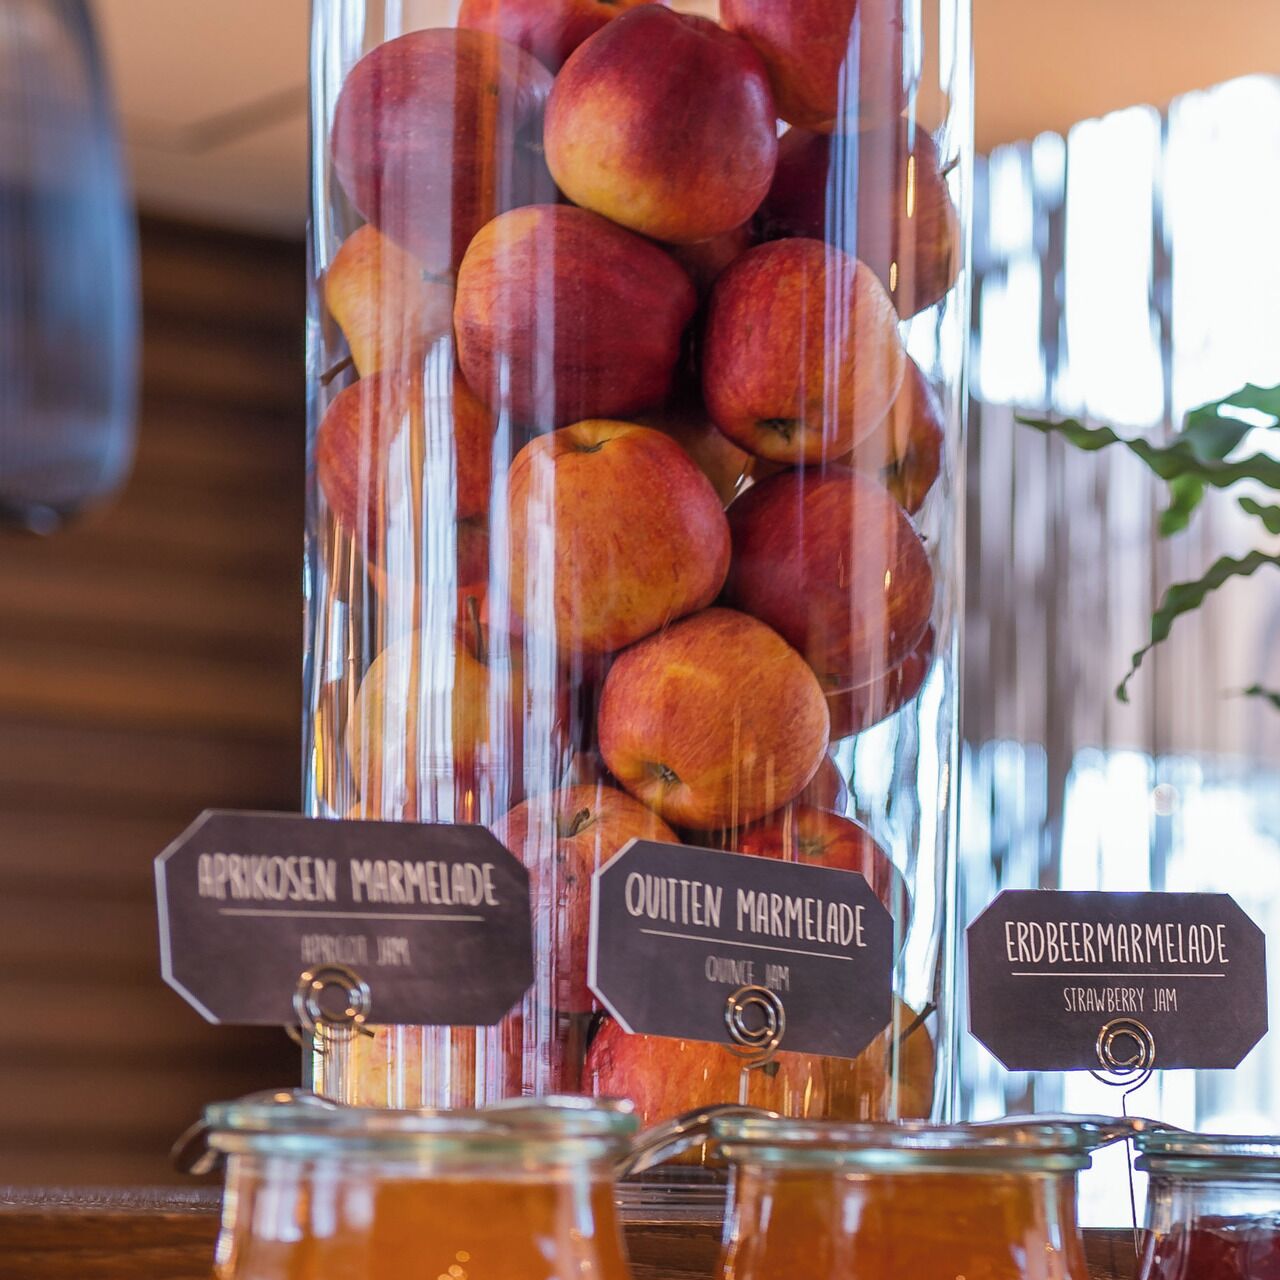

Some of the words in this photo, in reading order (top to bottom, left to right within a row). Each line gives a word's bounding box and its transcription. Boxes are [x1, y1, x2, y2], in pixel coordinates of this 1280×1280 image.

[197, 852, 337, 902] APRIKOSEN
[350, 858, 501, 907] MARMELADE
[624, 871, 723, 928] QUITTEN
[736, 887, 868, 948] MARMELADE
[1004, 921, 1230, 964] ERDBEERMARMELADE
[1063, 987, 1145, 1013] STRAWBERRY
[1152, 987, 1178, 1013] JAM
